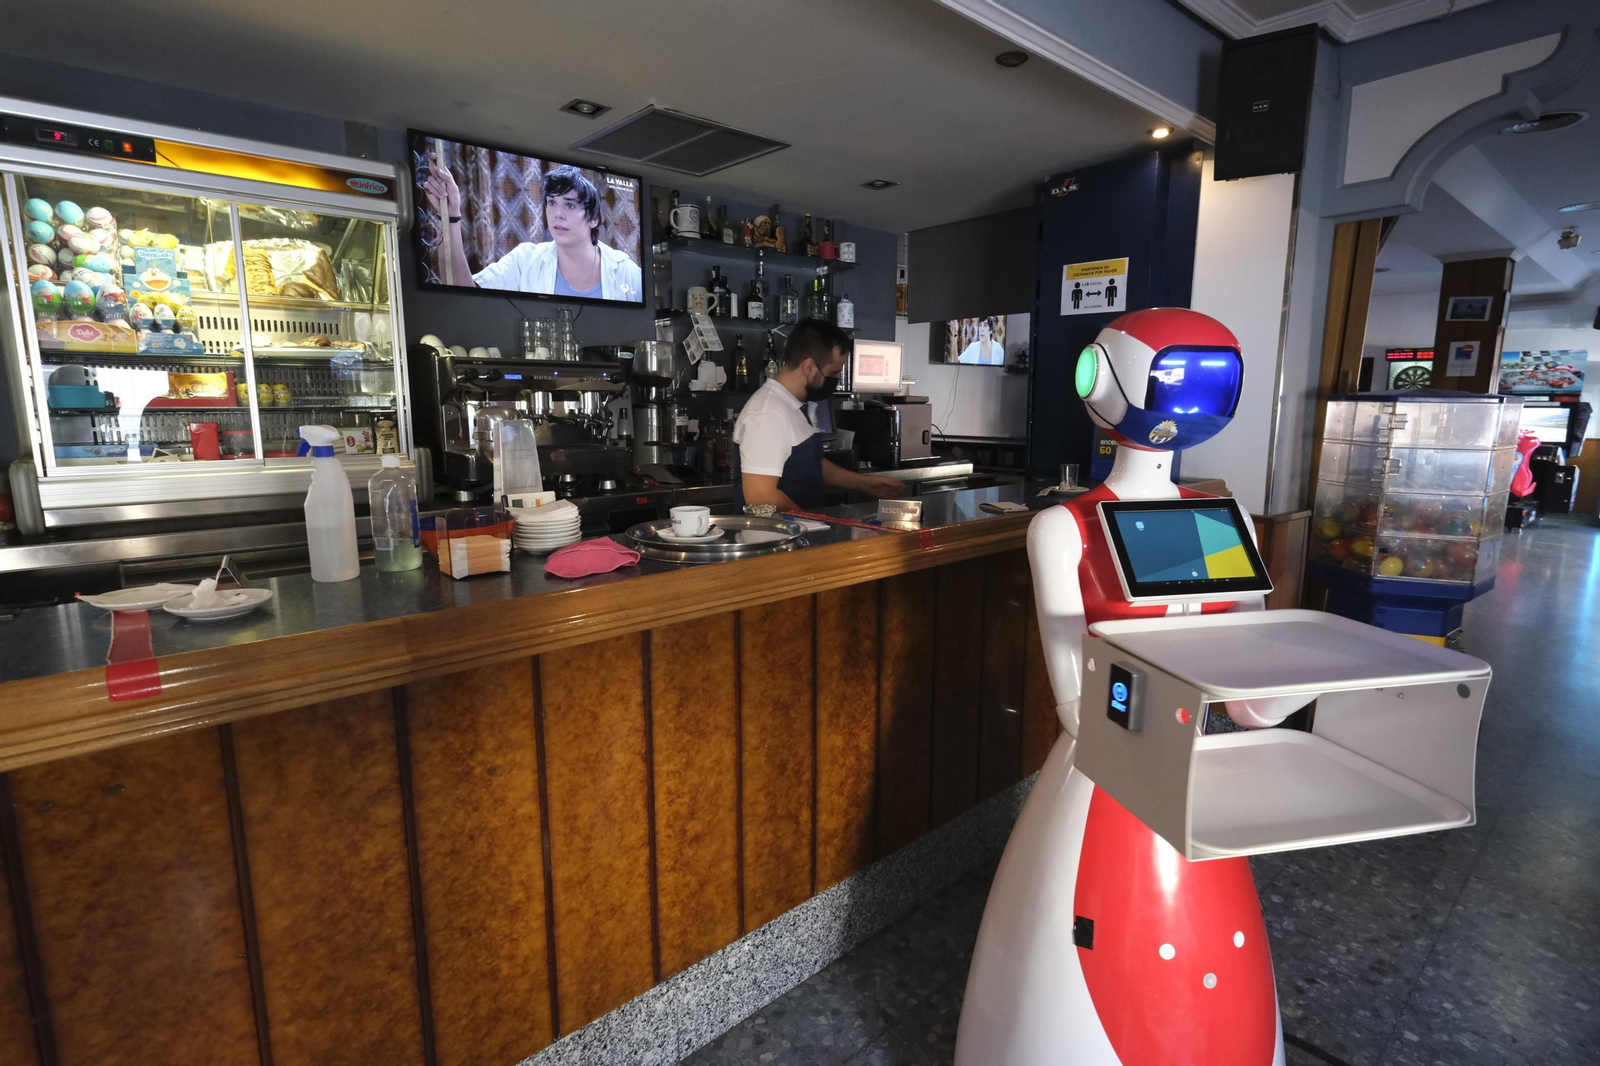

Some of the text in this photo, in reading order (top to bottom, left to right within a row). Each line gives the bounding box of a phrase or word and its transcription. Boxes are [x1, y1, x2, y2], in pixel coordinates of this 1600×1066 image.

[358, 180, 385, 192] infrico
[606, 176, 634, 188] LA VALLA
